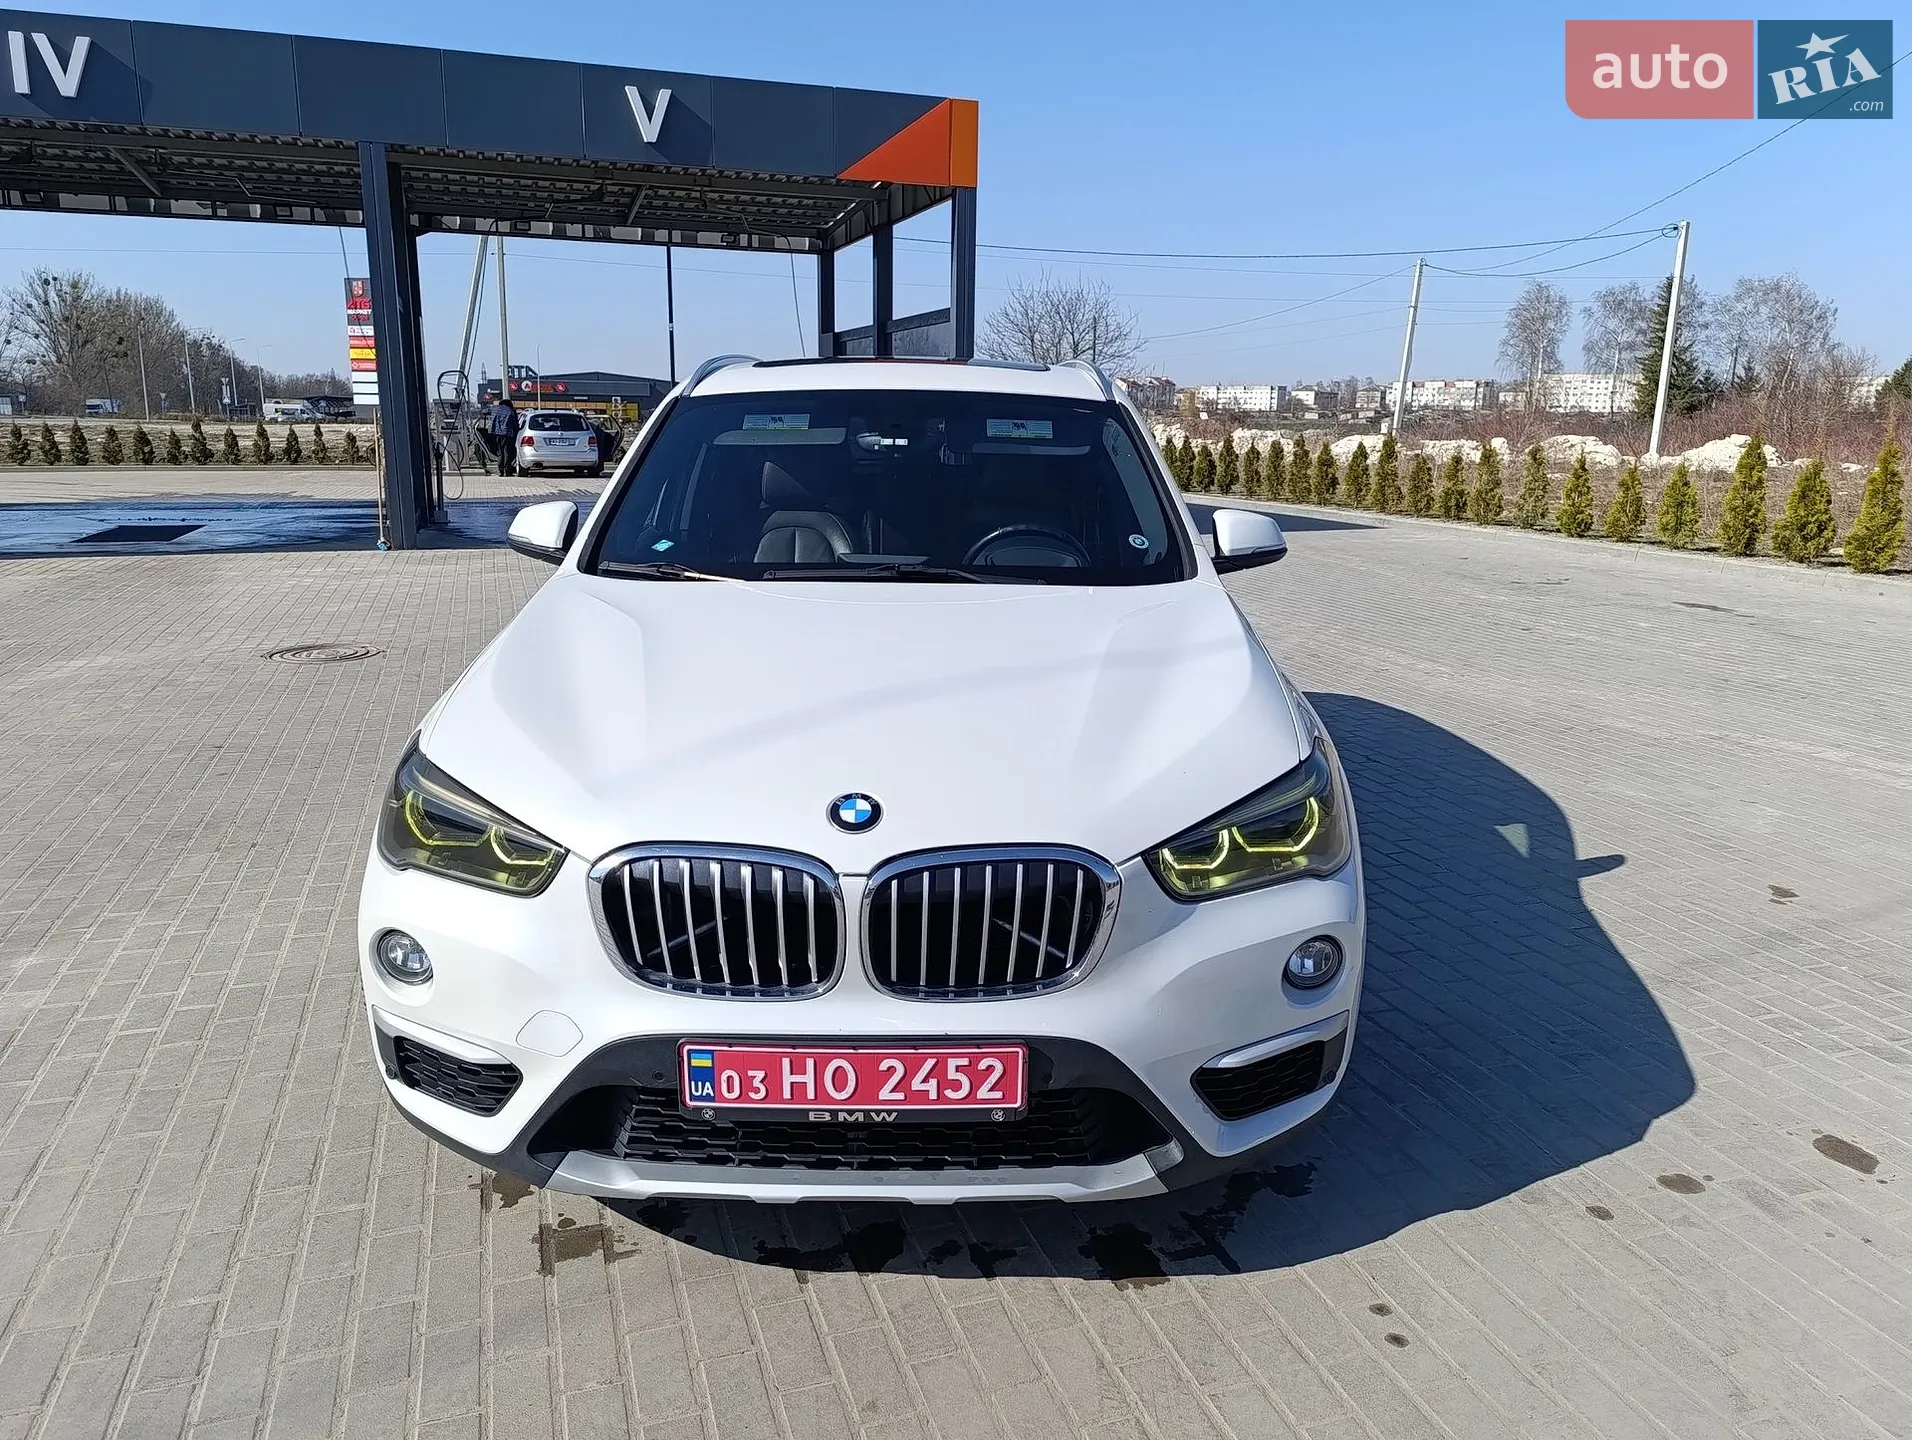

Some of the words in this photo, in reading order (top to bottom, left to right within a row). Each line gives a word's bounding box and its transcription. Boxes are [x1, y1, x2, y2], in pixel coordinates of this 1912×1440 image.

[8, 30, 91, 98] IV
[624, 85, 672, 143] V
[690, 1081, 715, 1097] UA
[720, 1069, 768, 1100] 03
[781, 1057, 859, 1101] HO
[877, 1056, 1005, 1101] 2452
[808, 1110, 900, 1123] BMW
